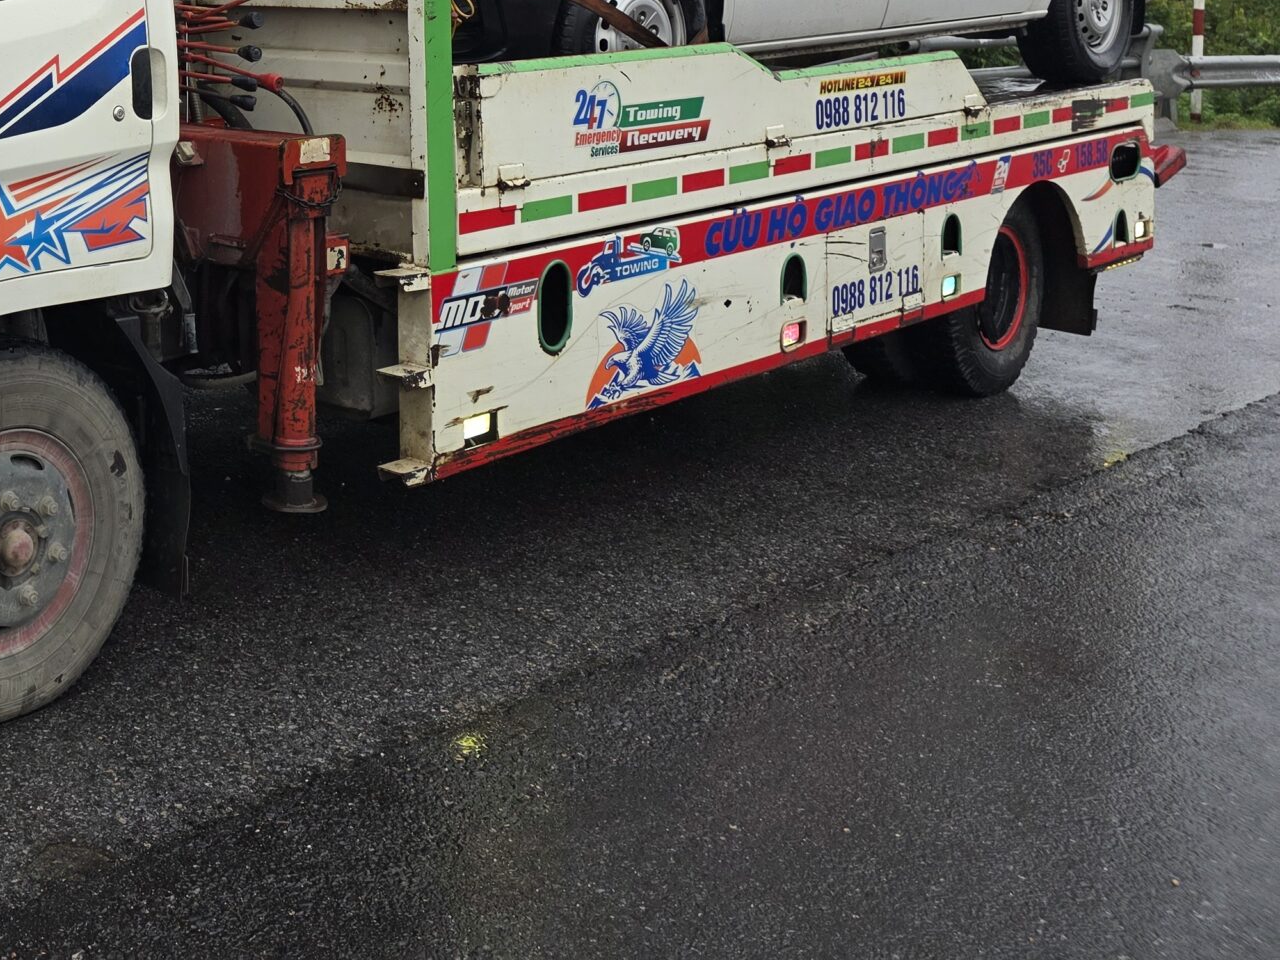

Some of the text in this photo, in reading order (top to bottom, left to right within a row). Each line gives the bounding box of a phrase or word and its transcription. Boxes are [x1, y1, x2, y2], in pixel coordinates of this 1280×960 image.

[819, 78, 856, 95] HOTLINE
[626, 104, 681, 122] Towing
[815, 88, 905, 130] 0988 812 116
[575, 128, 622, 147] Emergency
[626, 126, 702, 146] Recovery
[590, 144, 618, 158] Services
[1032, 140, 1108, 178] 35C 158.58
[705, 170, 962, 257] CỨU HỘ GIAO THÔNG
[615, 258, 659, 277] TOWING
[508, 285, 535, 297] Motor
[832, 265, 920, 316] 0988 812 116
[508, 298, 530, 314] port
